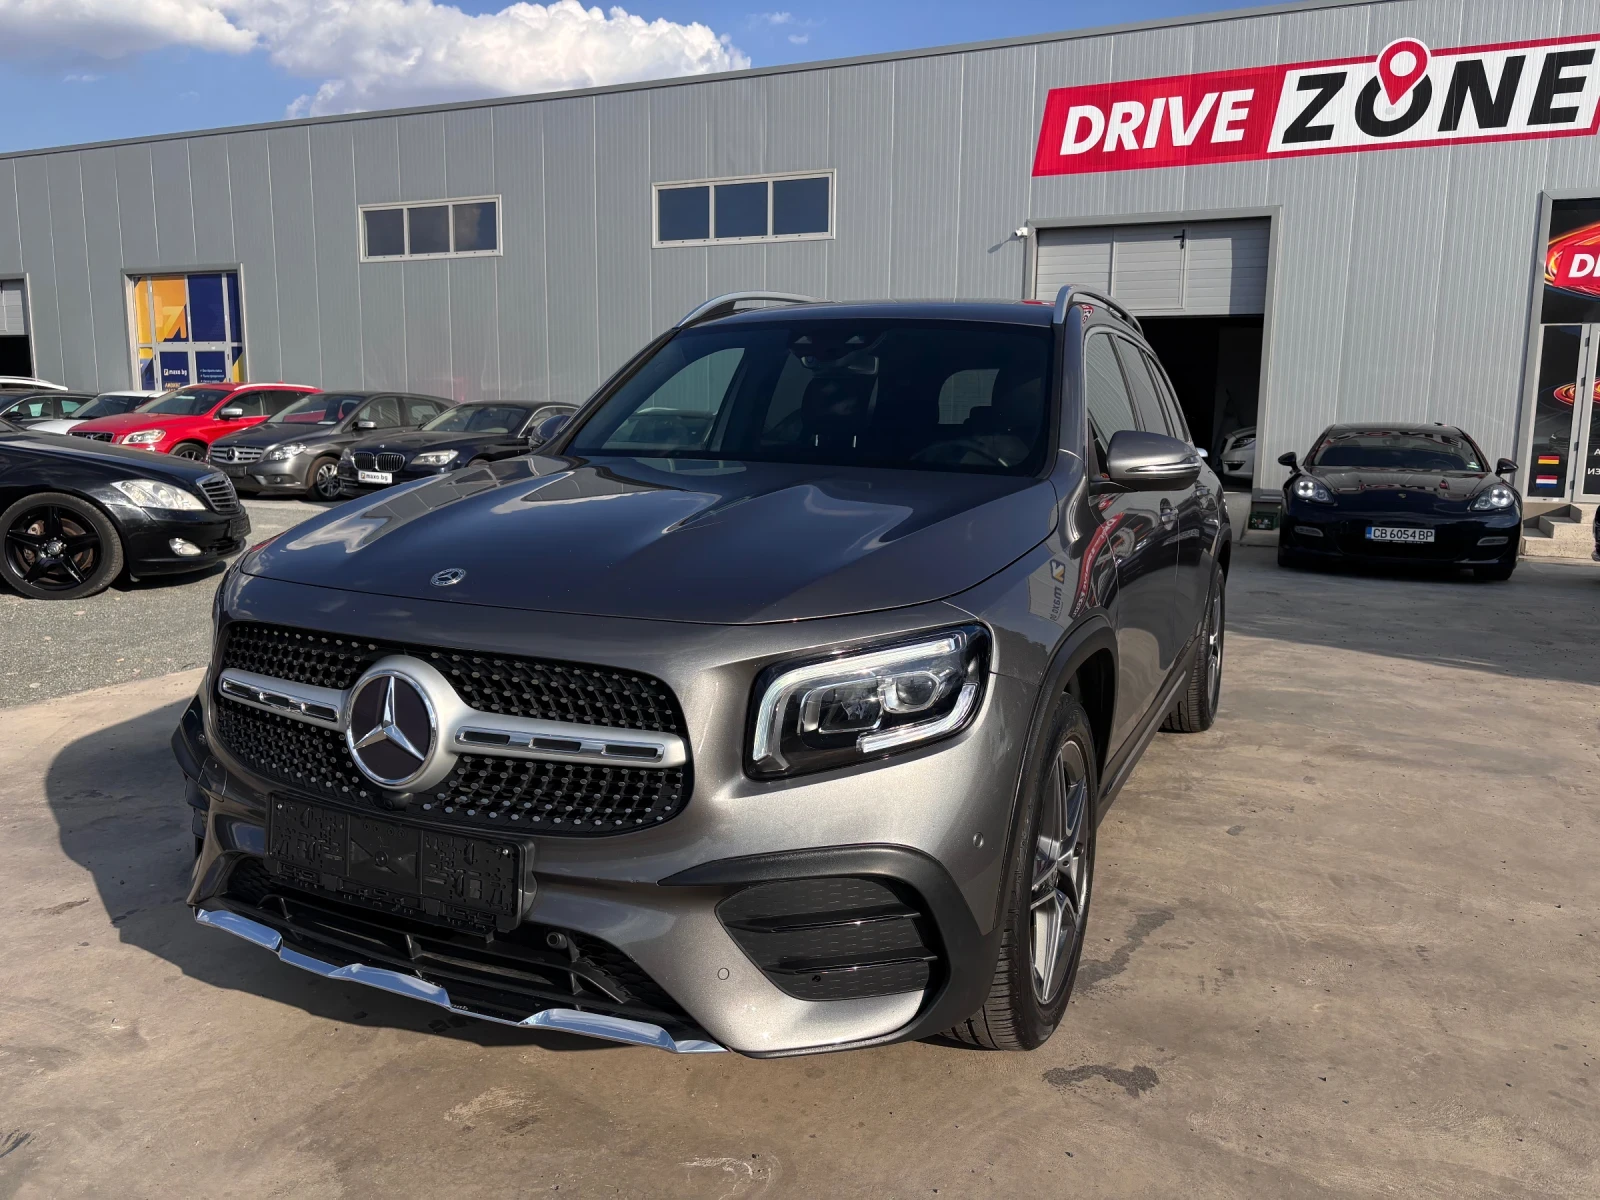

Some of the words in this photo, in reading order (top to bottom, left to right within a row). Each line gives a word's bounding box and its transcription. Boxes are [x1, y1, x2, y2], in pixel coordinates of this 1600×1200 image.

[1059, 89, 1254, 156] DRIVE
[1281, 48, 1596, 145] ZONE
[1373, 528, 1387, 539] CB
[1389, 529, 1416, 540] 6054
[1418, 530, 1433, 540] BP
